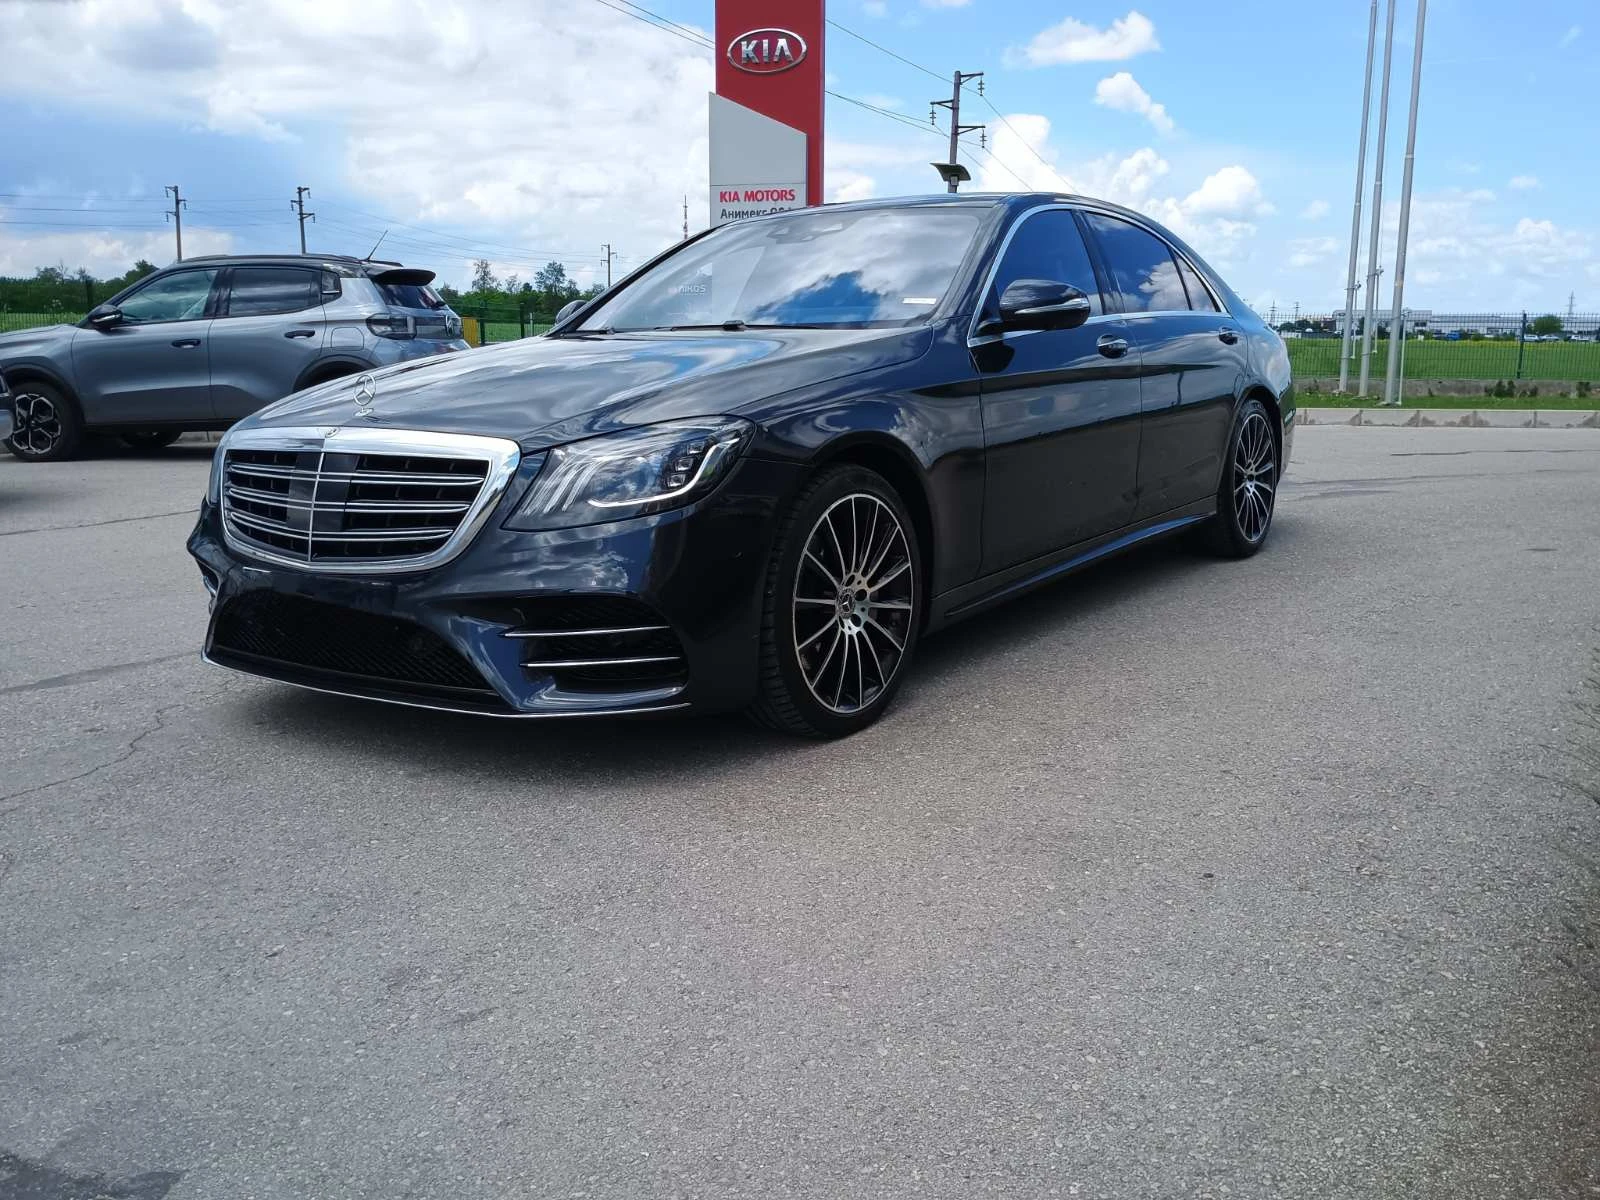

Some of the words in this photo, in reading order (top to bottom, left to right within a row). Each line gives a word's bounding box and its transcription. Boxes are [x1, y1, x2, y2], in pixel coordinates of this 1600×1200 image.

[741, 38, 794, 64] KIA
[719, 191, 740, 203] KIA
[743, 188, 796, 202] MOTORS
